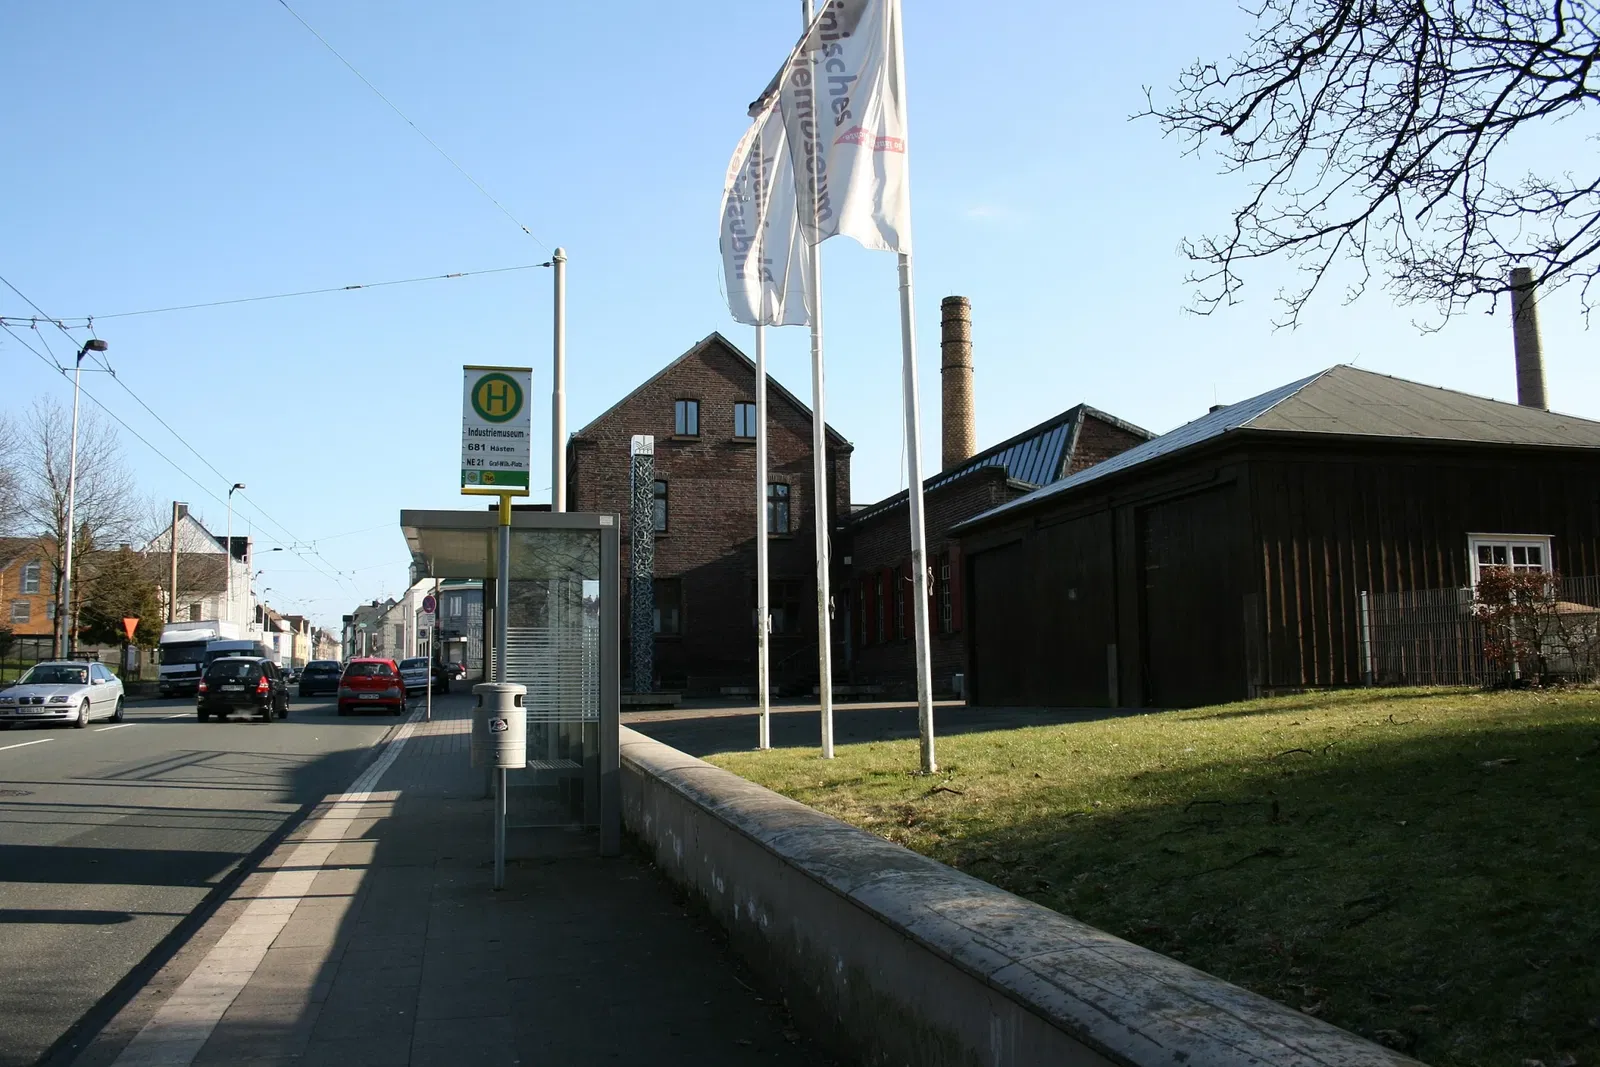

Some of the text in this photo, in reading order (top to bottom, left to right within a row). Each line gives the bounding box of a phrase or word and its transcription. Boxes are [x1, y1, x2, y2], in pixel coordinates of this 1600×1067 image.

[486, 383, 508, 412] H
[468, 427, 524, 438] Industriemuseum
[467, 443, 486, 451] 681
[466, 458, 476, 466] NE
[476, 458, 484, 466] 21
